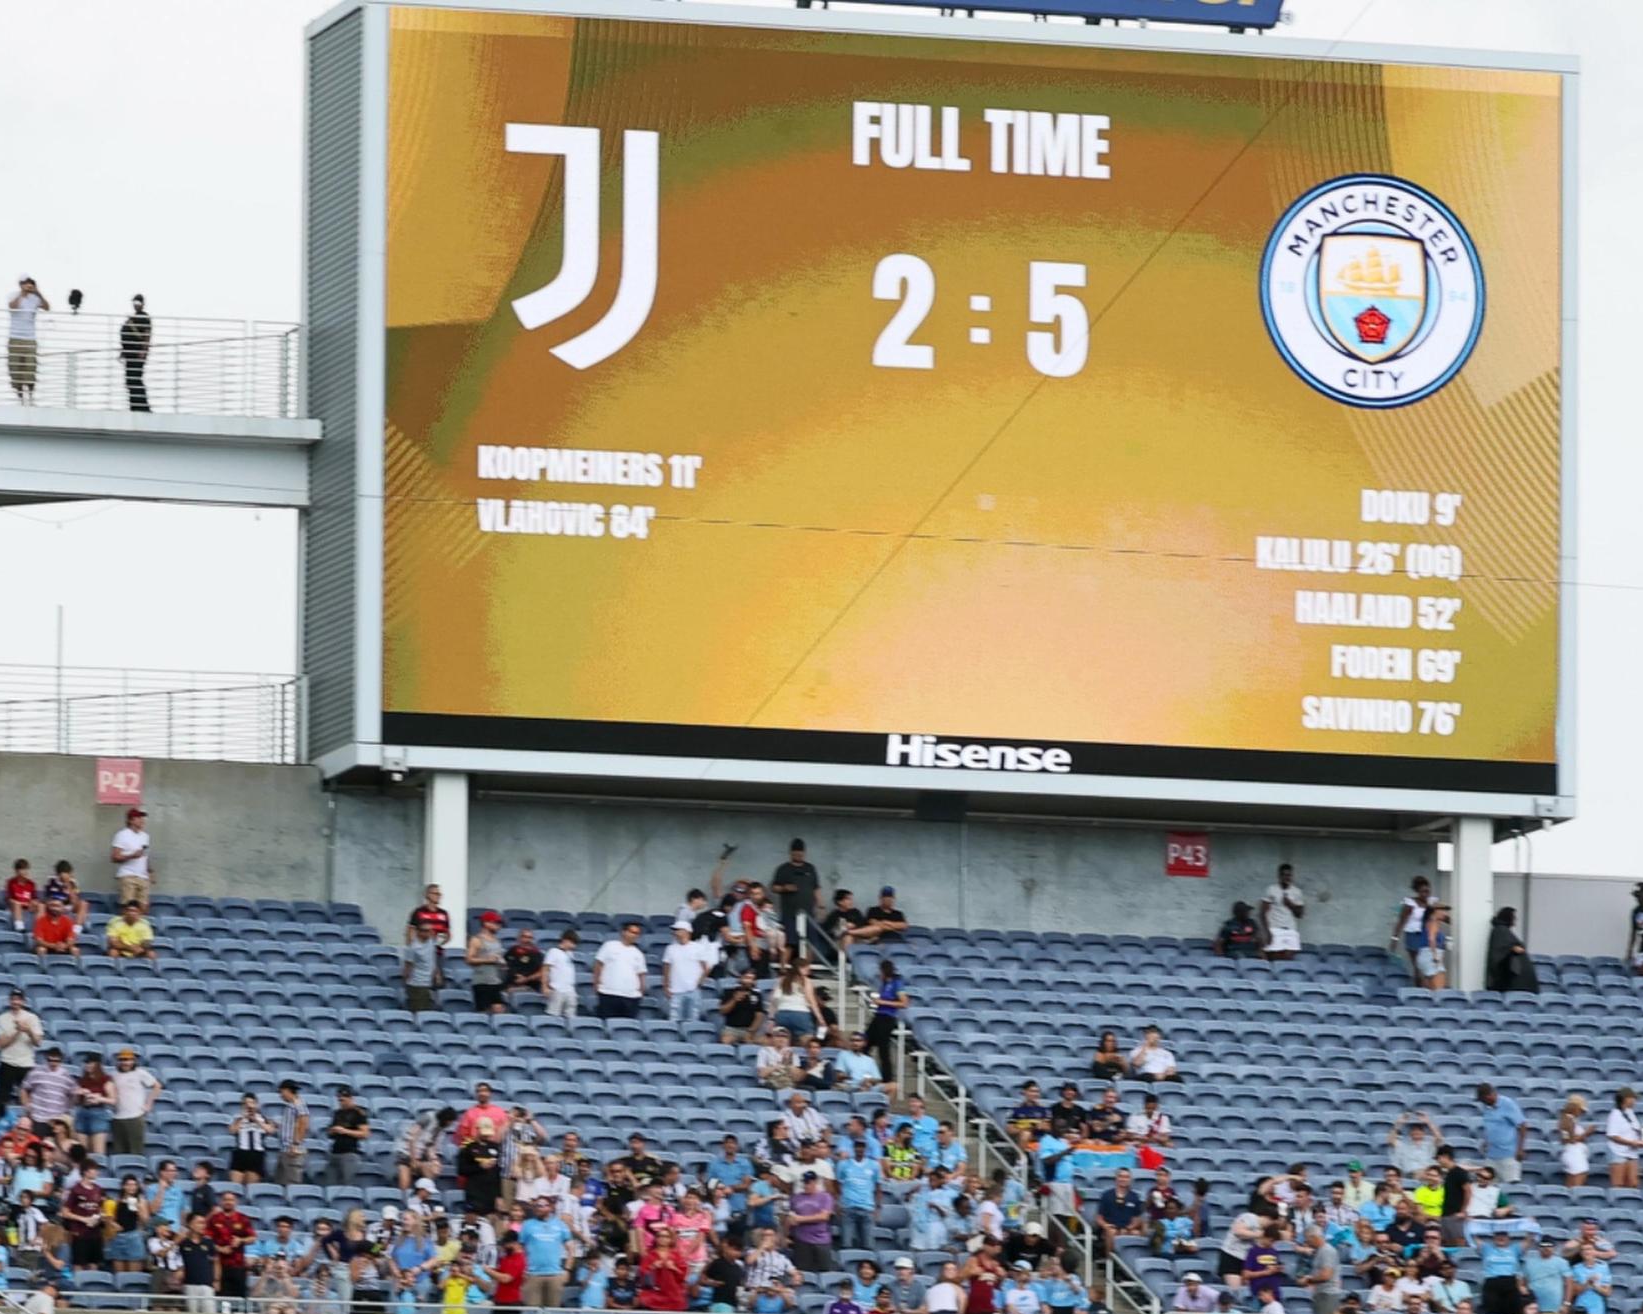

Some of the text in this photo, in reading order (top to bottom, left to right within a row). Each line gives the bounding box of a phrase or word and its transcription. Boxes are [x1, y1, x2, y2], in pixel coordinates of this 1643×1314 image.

[853, 101, 1111, 179] FULL TIME
[1287, 191, 1458, 267] MANCHESTER
[872, 253, 935, 369] 2
[1026, 261, 1089, 378] 5
[1343, 369, 1404, 390] CITY
[477, 445, 663, 487] KOOPMEINERS
[477, 498, 606, 537] VLAHOVIC
[1361, 489, 1430, 525] DOKU
[1256, 536, 1352, 573] KALULU
[1295, 590, 1462, 631] HAALAND 52'
[1331, 644, 1413, 681] FODEN
[1301, 695, 1462, 736] SAVINHO 76'
[885, 733, 1072, 773] Hisense
[98, 769, 141, 794] P42
[1167, 843, 1208, 866] P43
